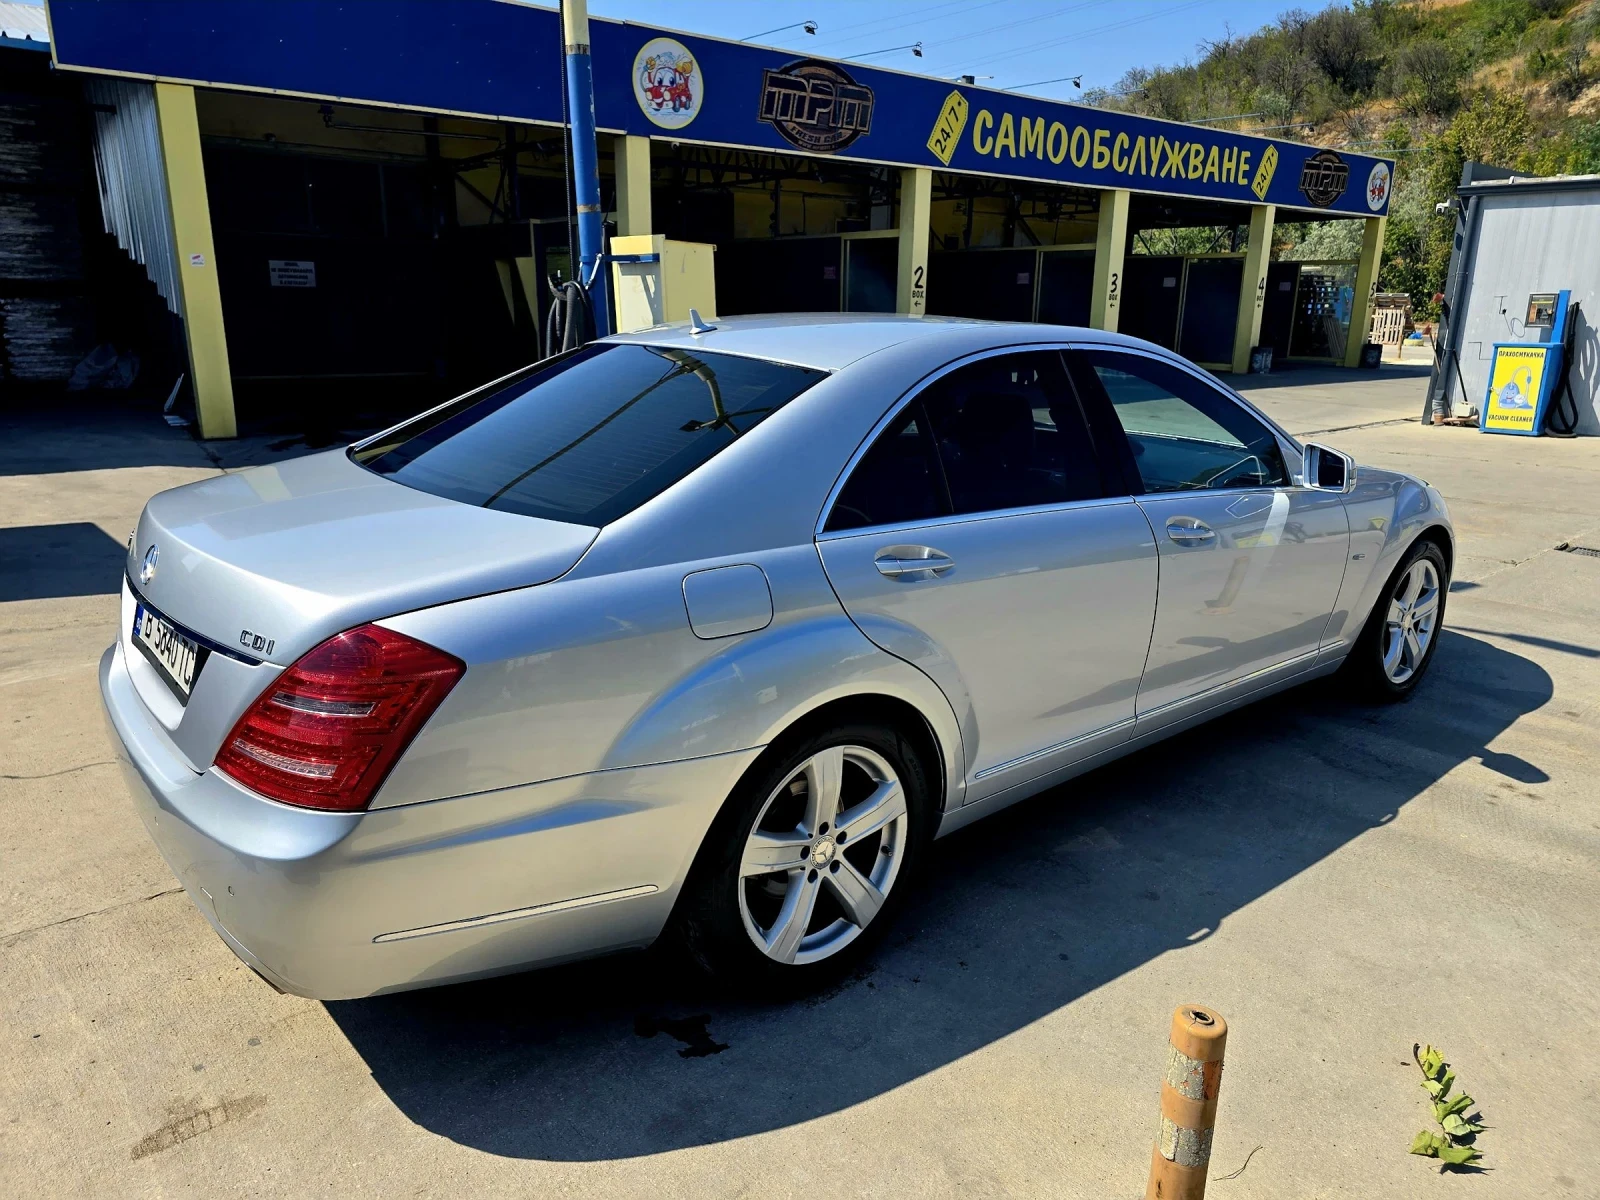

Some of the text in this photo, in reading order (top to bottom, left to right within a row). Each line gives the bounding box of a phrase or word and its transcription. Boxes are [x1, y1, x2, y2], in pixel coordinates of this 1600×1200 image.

[790, 125, 823, 144] FRESH
[934, 106, 960, 155] 24/7
[972, 109, 1251, 186] САМООБСЛУЖВАНЕ
[1256, 156, 1274, 193] 24/7
[913, 265, 924, 289] 2
[1110, 272, 1119, 293] 3
[1258, 276, 1265, 296] 4
[912, 290, 924, 299] BOX
[1498, 350, 1544, 359] ПРАХОСМУКАЧКА
[1488, 414, 1533, 423] VACUUM CLEANER
[155, 620, 179, 669] 5840
[179, 636, 195, 686] TC
[239, 629, 275, 656] CDI
